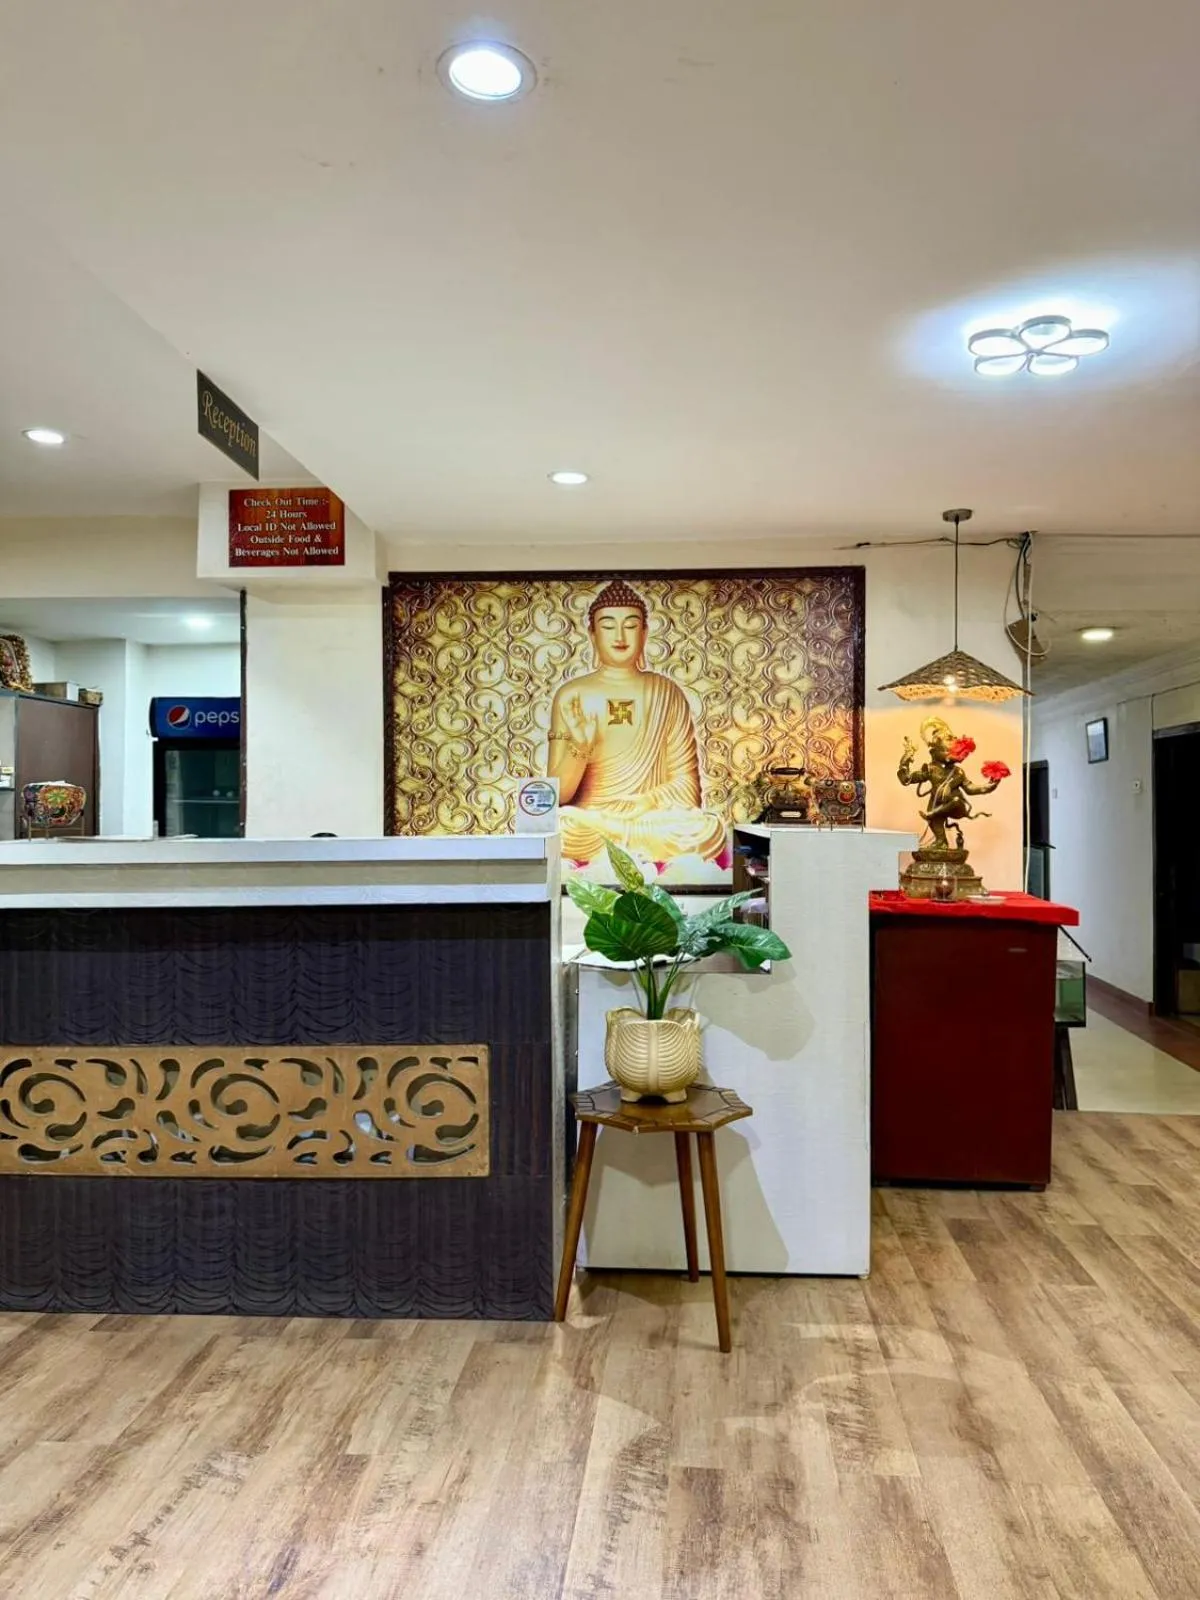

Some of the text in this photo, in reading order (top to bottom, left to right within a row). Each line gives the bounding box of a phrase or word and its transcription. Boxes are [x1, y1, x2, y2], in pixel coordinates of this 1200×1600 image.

[203, 390, 257, 458] Reception
[243, 498, 272, 508] Check
[275, 498, 292, 507] Out
[297, 496, 320, 507] Time
[266, 510, 308, 519] 24 Hours
[237, 521, 337, 532] Local ID Not Allowed
[249, 534, 322, 544] Outside Food &
[234, 546, 340, 557] Beverages Not Allowed
[194, 710, 241, 728] peps
